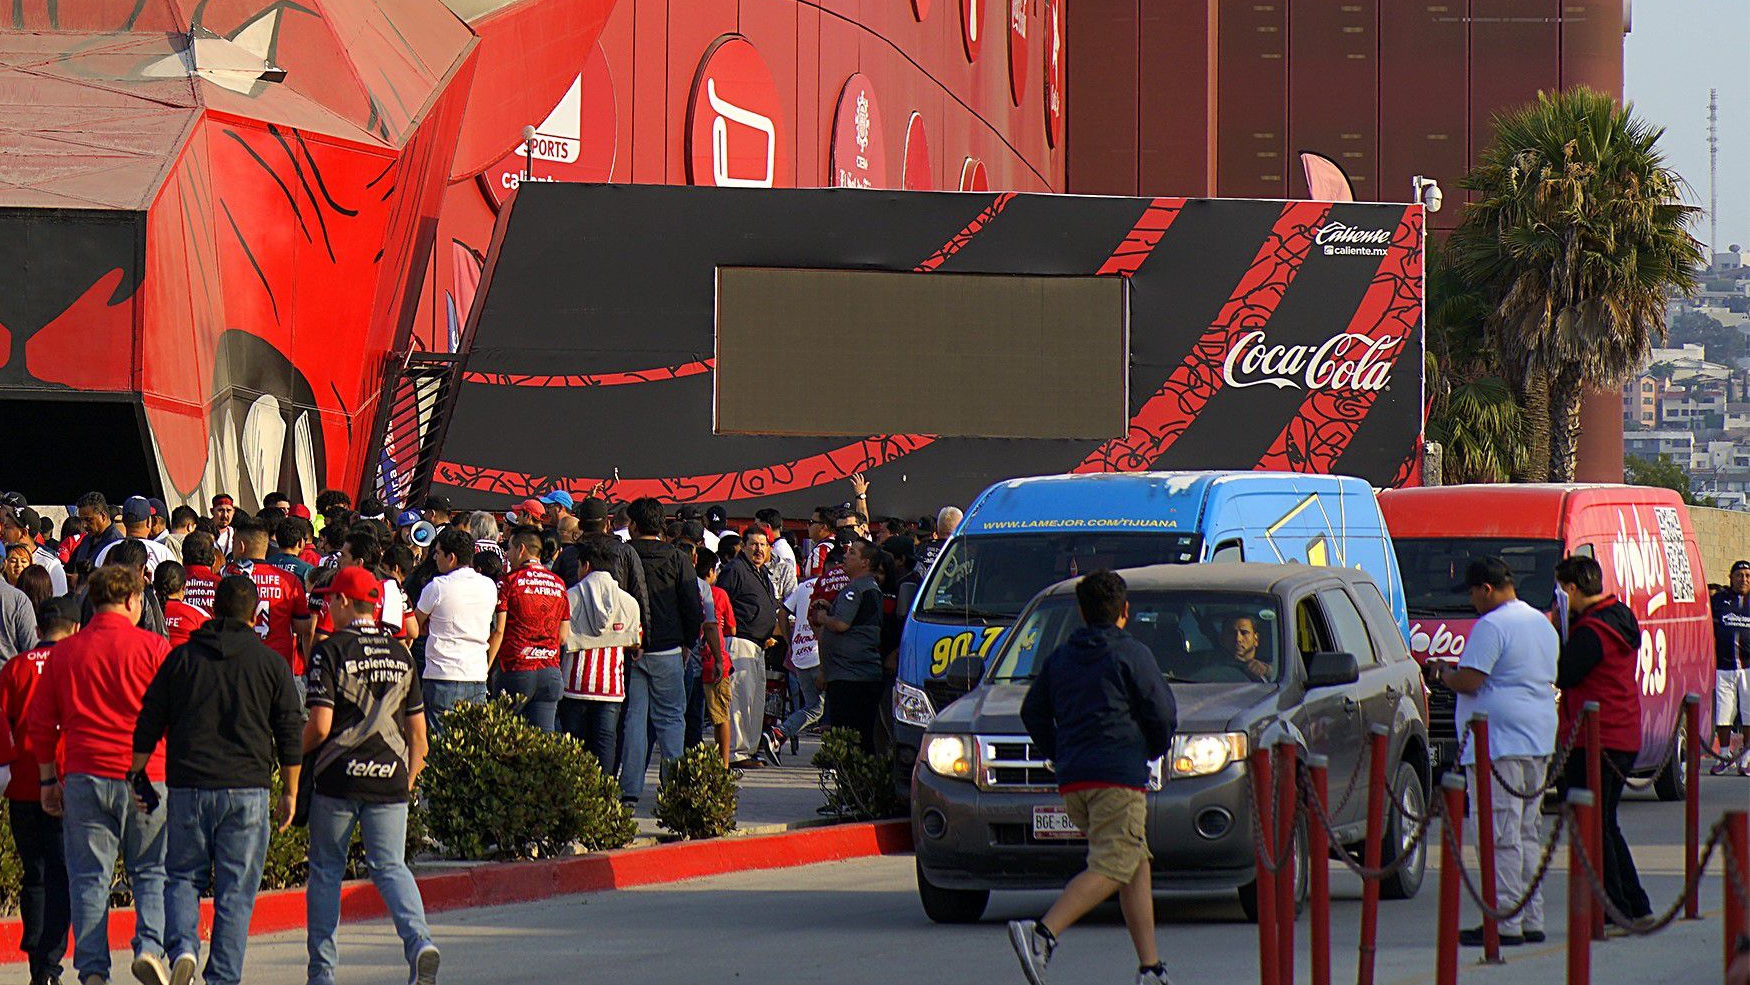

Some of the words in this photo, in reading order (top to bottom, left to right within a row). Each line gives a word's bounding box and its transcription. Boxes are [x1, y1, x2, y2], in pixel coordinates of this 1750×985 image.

[1316, 221, 1391, 245] Caliente
[1334, 247, 1388, 256] caliente.mx
[1224, 331, 1402, 391] Coca-Cola
[346, 760, 398, 778] telcel
